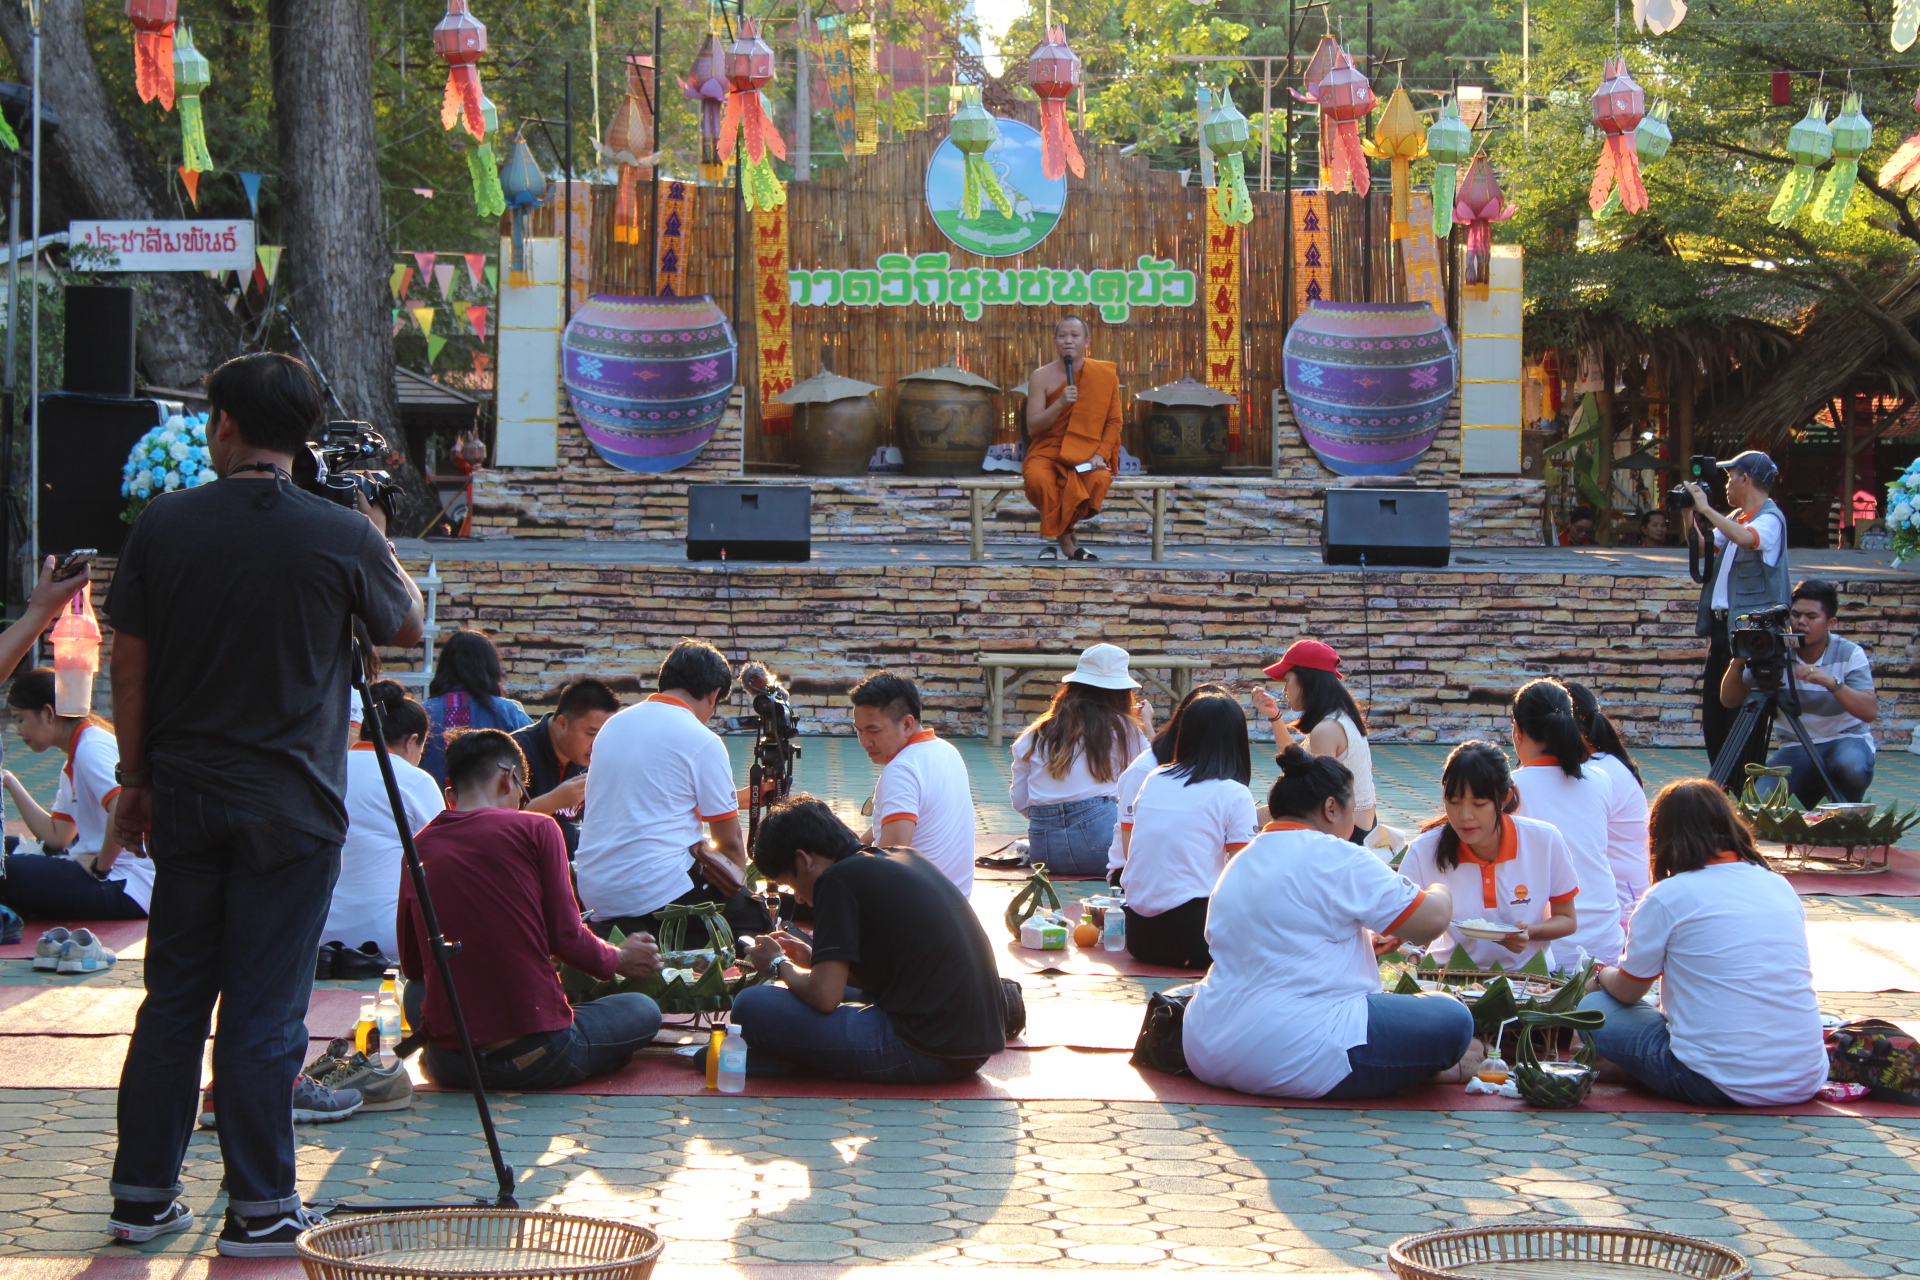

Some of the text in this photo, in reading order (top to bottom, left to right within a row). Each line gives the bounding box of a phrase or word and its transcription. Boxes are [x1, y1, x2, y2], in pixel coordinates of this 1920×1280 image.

[84, 225, 238, 253] ประชาสัมพันธ์
